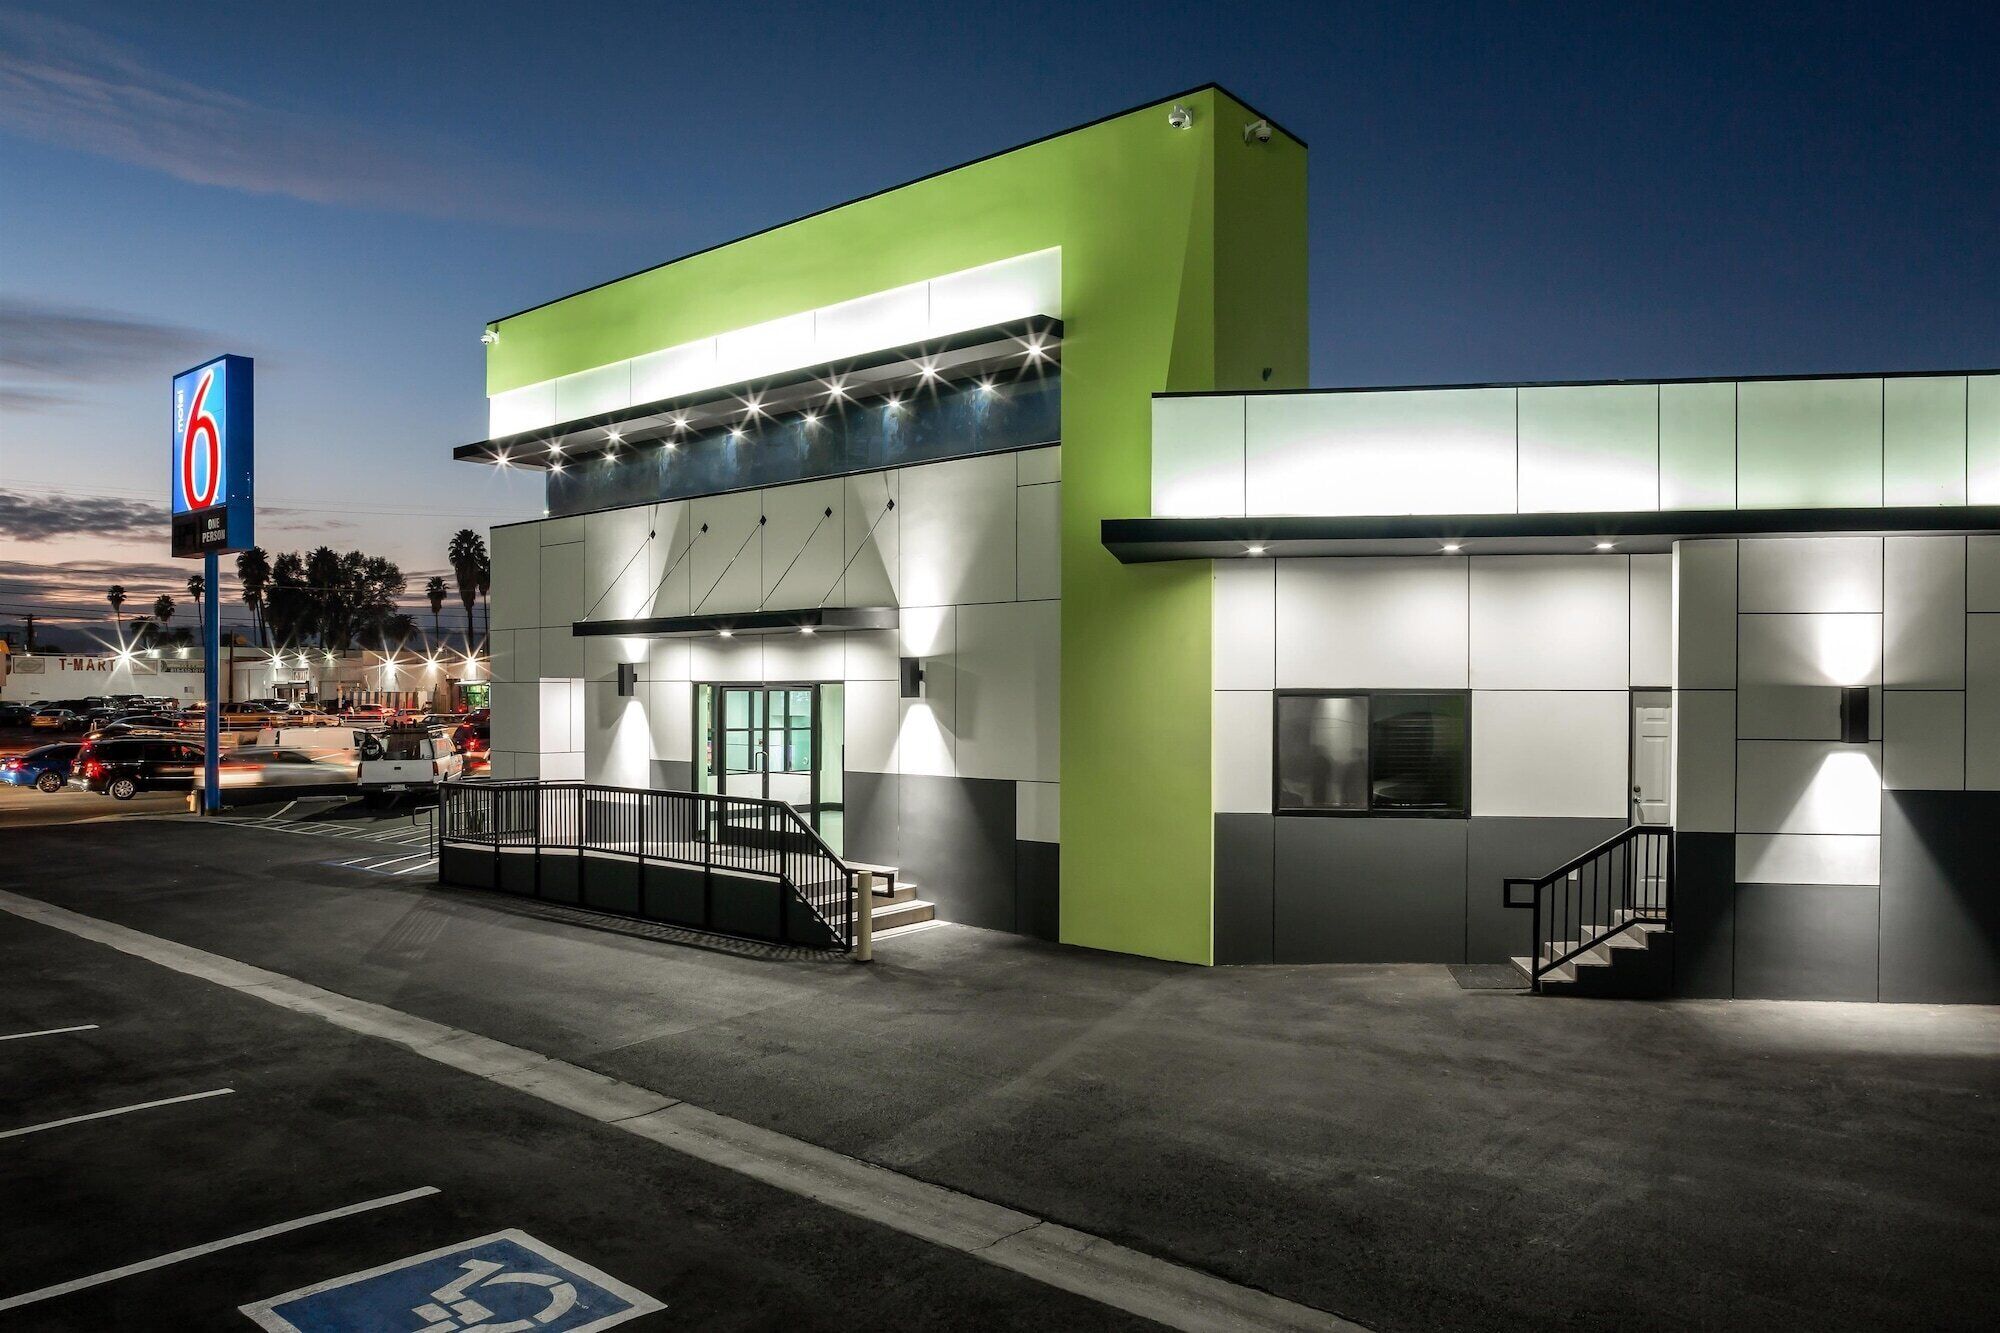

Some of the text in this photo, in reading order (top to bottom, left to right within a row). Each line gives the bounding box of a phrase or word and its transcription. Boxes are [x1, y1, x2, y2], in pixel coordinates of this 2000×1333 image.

[182, 368, 221, 511] 6
[207, 517, 220, 530] ONE
[202, 529, 226, 544] PERSON
[59, 658, 116, 672] T-MART
